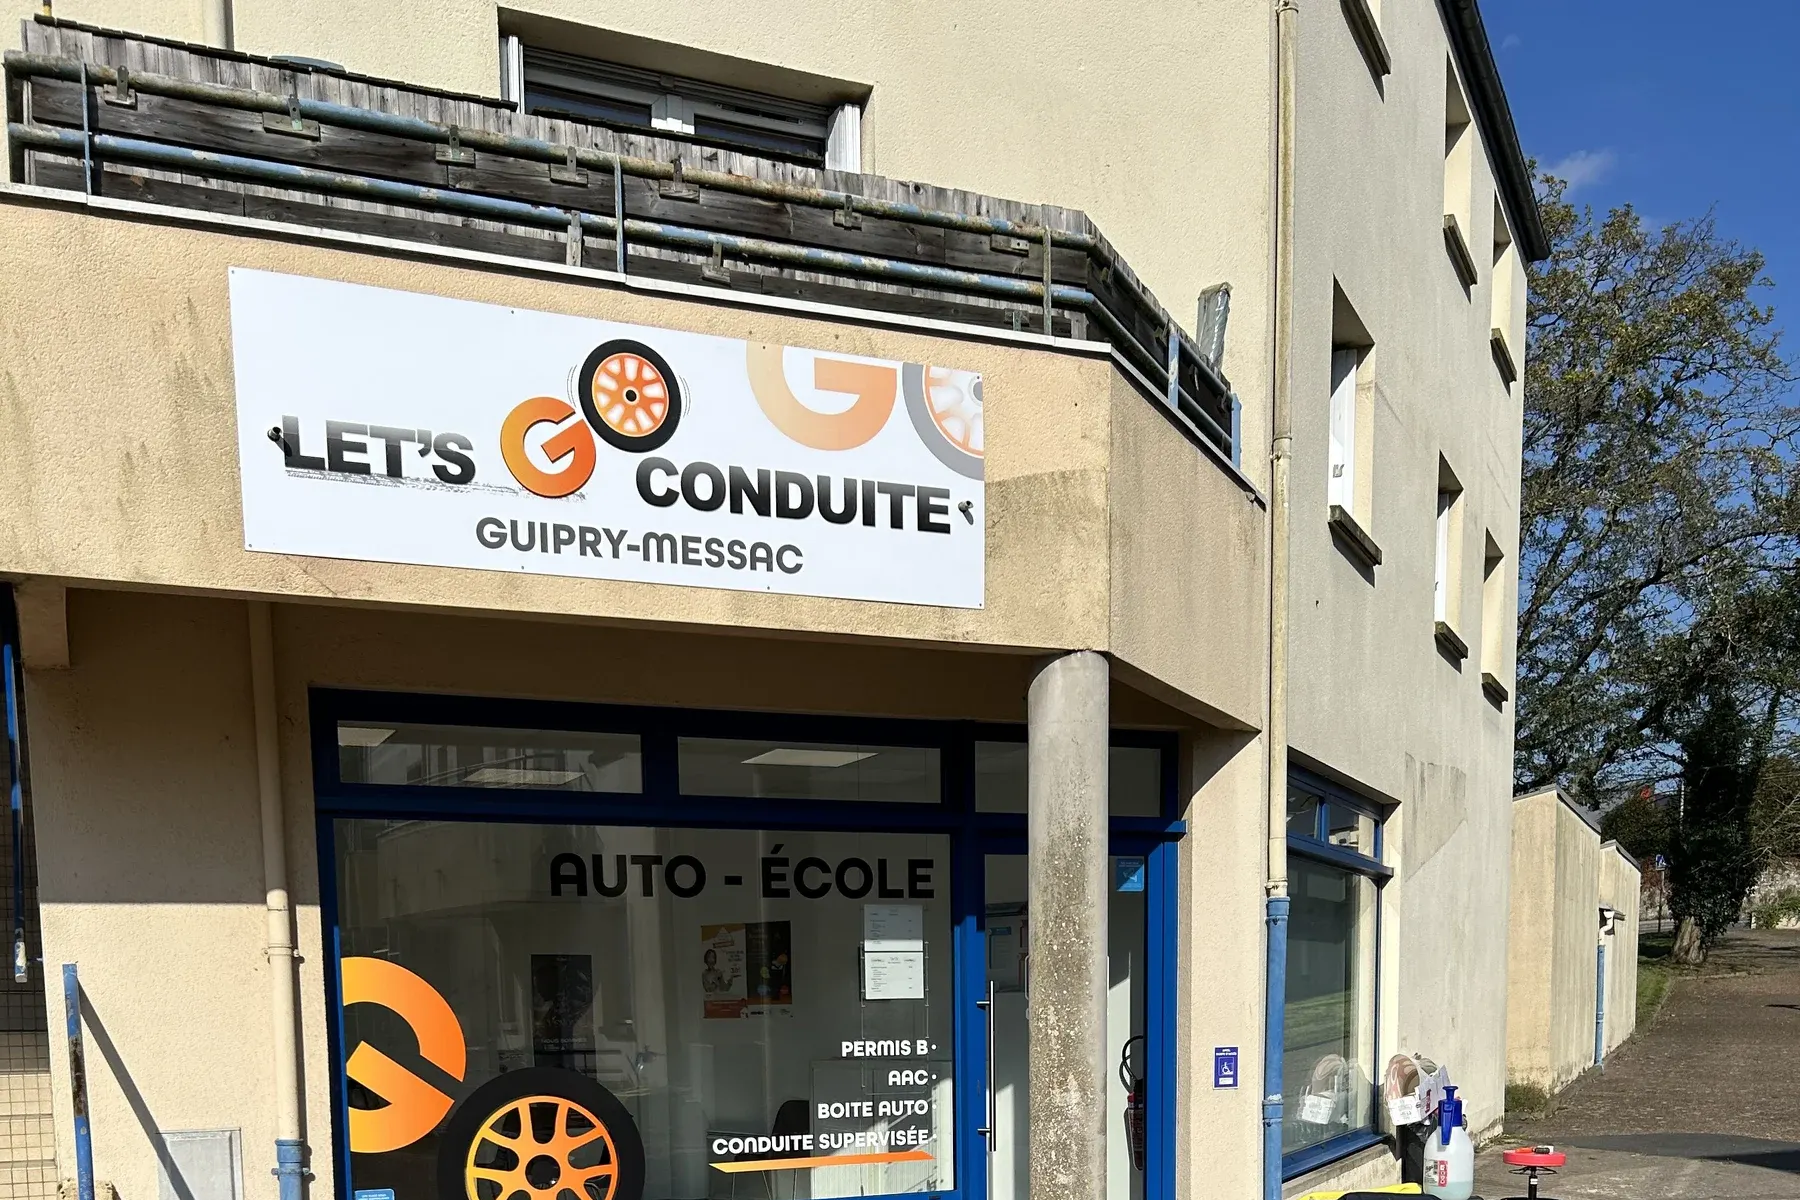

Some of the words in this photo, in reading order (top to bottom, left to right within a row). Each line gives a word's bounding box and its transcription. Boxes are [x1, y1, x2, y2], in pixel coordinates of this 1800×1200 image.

[283, 414, 476, 486] LET'S
[636, 456, 951, 535] CONDUITE
[476, 516, 804, 574] GUIPRY-MESSAC
[550, 852, 706, 898] AUTO
[761, 844, 935, 899] ÉCOLE
[841, 1040, 911, 1057] PERMIS
[916, 1039, 929, 1055] B
[888, 1070, 929, 1086] AAC
[817, 1102, 874, 1119] BOITE
[878, 1100, 929, 1117] AUTO
[712, 1134, 814, 1155] CONDUITE
[819, 1125, 929, 1150] SUPERVISÉE
